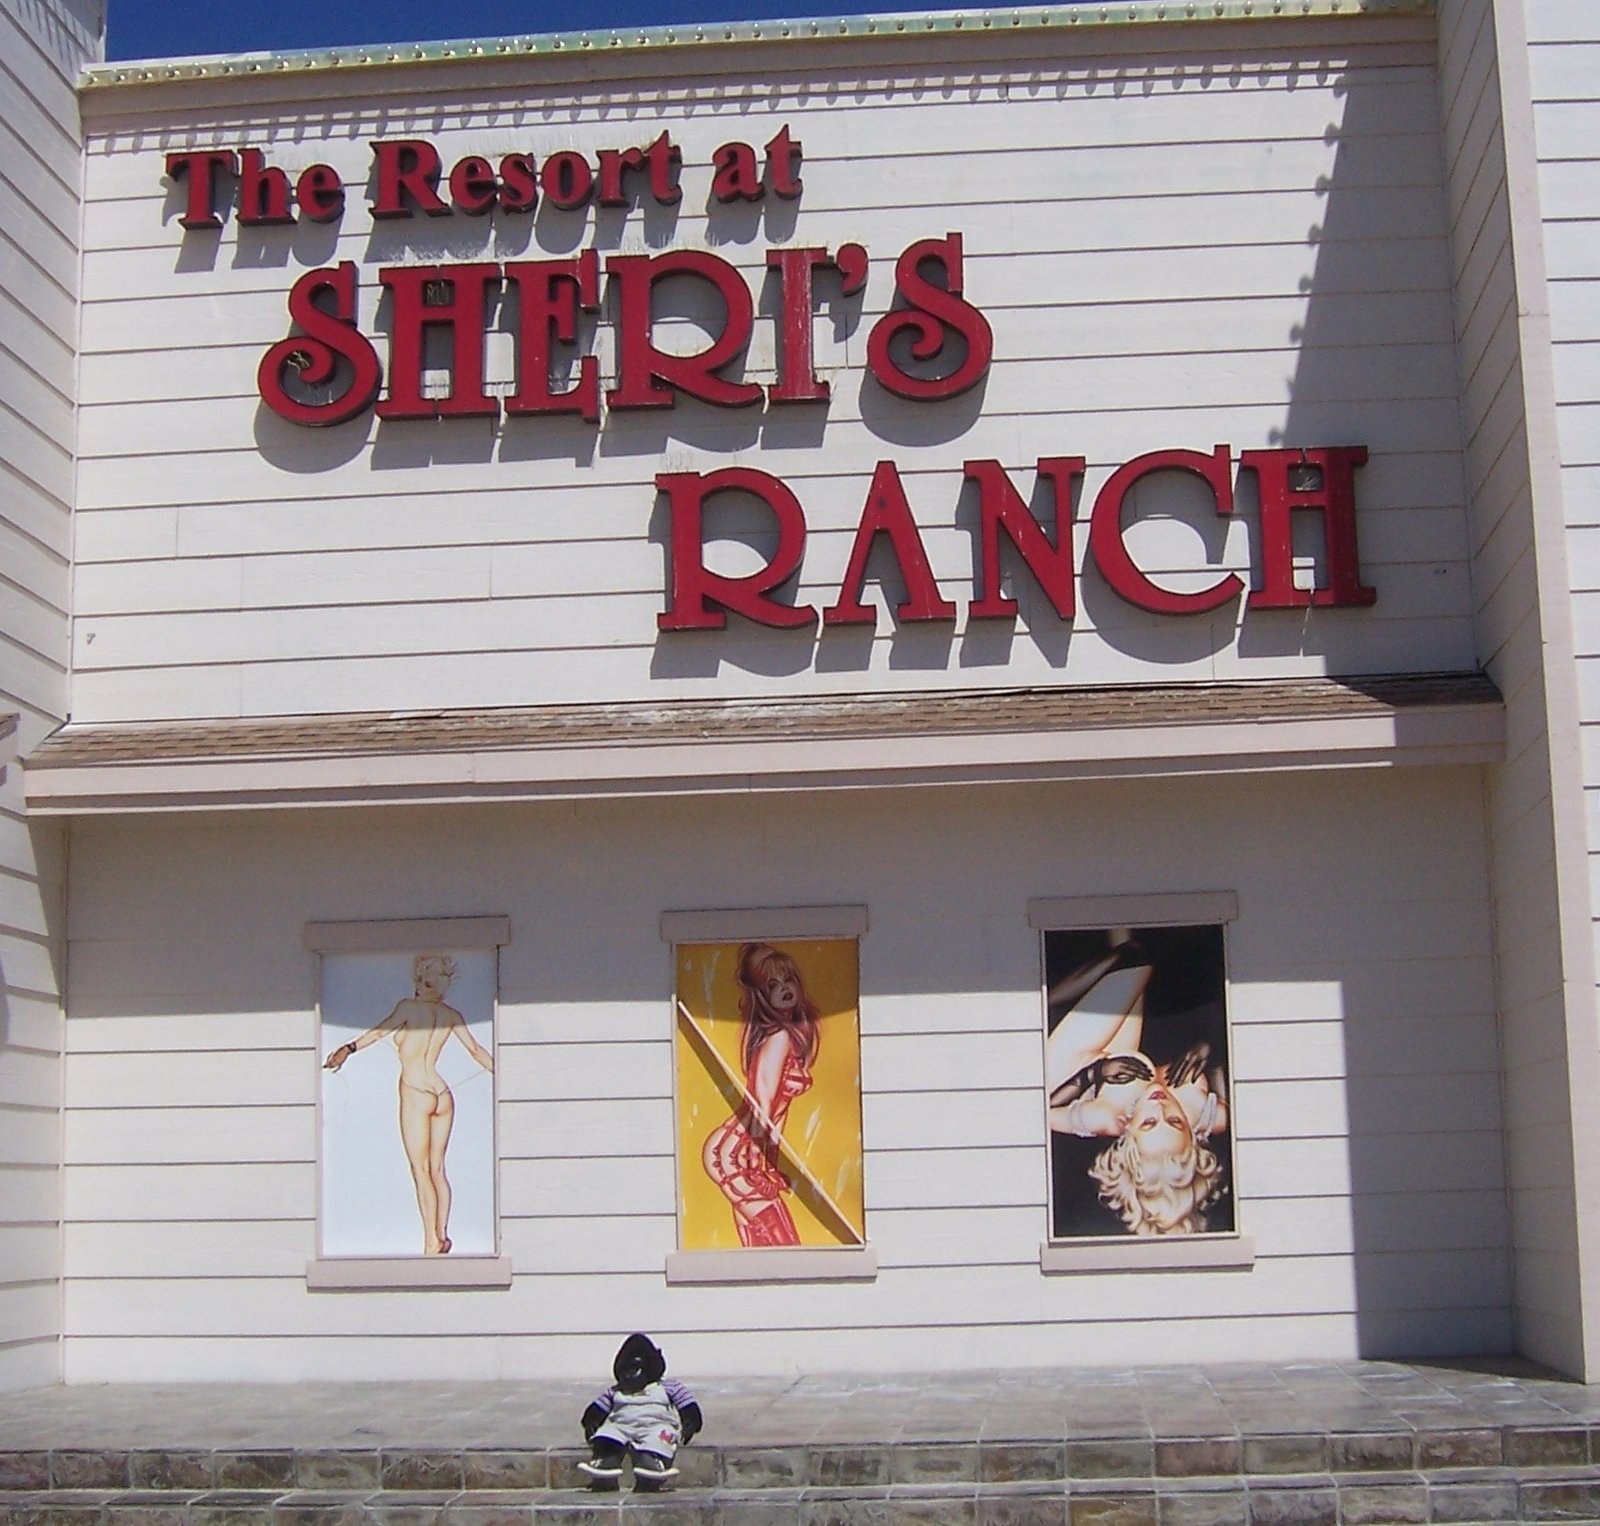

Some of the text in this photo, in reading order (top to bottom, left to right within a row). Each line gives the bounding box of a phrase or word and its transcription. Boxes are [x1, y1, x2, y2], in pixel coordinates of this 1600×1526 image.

[166, 124, 802, 225] The Resort at
[258, 232, 993, 424] SHERI'S
[655, 443, 1377, 633] RANCH
